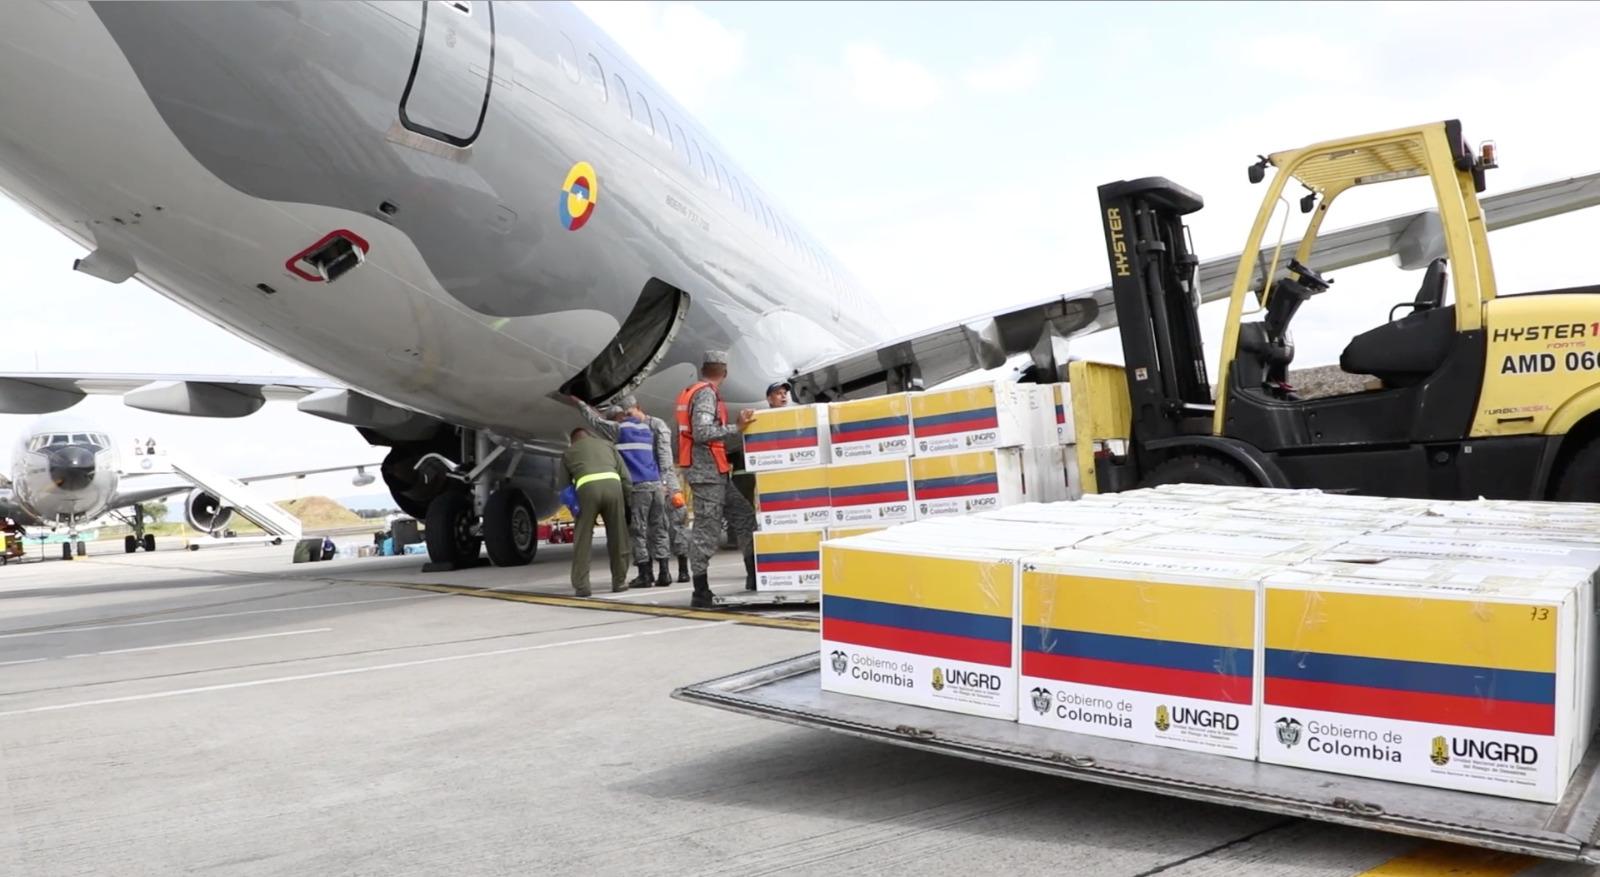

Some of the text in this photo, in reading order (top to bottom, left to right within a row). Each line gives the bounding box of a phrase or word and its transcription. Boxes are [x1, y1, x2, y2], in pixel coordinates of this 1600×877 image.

[1107, 208, 1130, 276] HYSTER
[1493, 323, 1586, 342] HYSTER
[1501, 351, 1600, 374] AMD 06
[852, 653, 914, 673] Gobierno de
[852, 666, 914, 688] Colombia
[945, 668, 1001, 691] UNGRD
[1056, 690, 1133, 712] Gobierno de
[1056, 705, 1133, 729] Colombia
[1172, 706, 1239, 731] UNGRD
[1307, 720, 1403, 745] Gobierno de
[1307, 737, 1403, 763] Colombia
[1452, 737, 1538, 765] UNGRD
